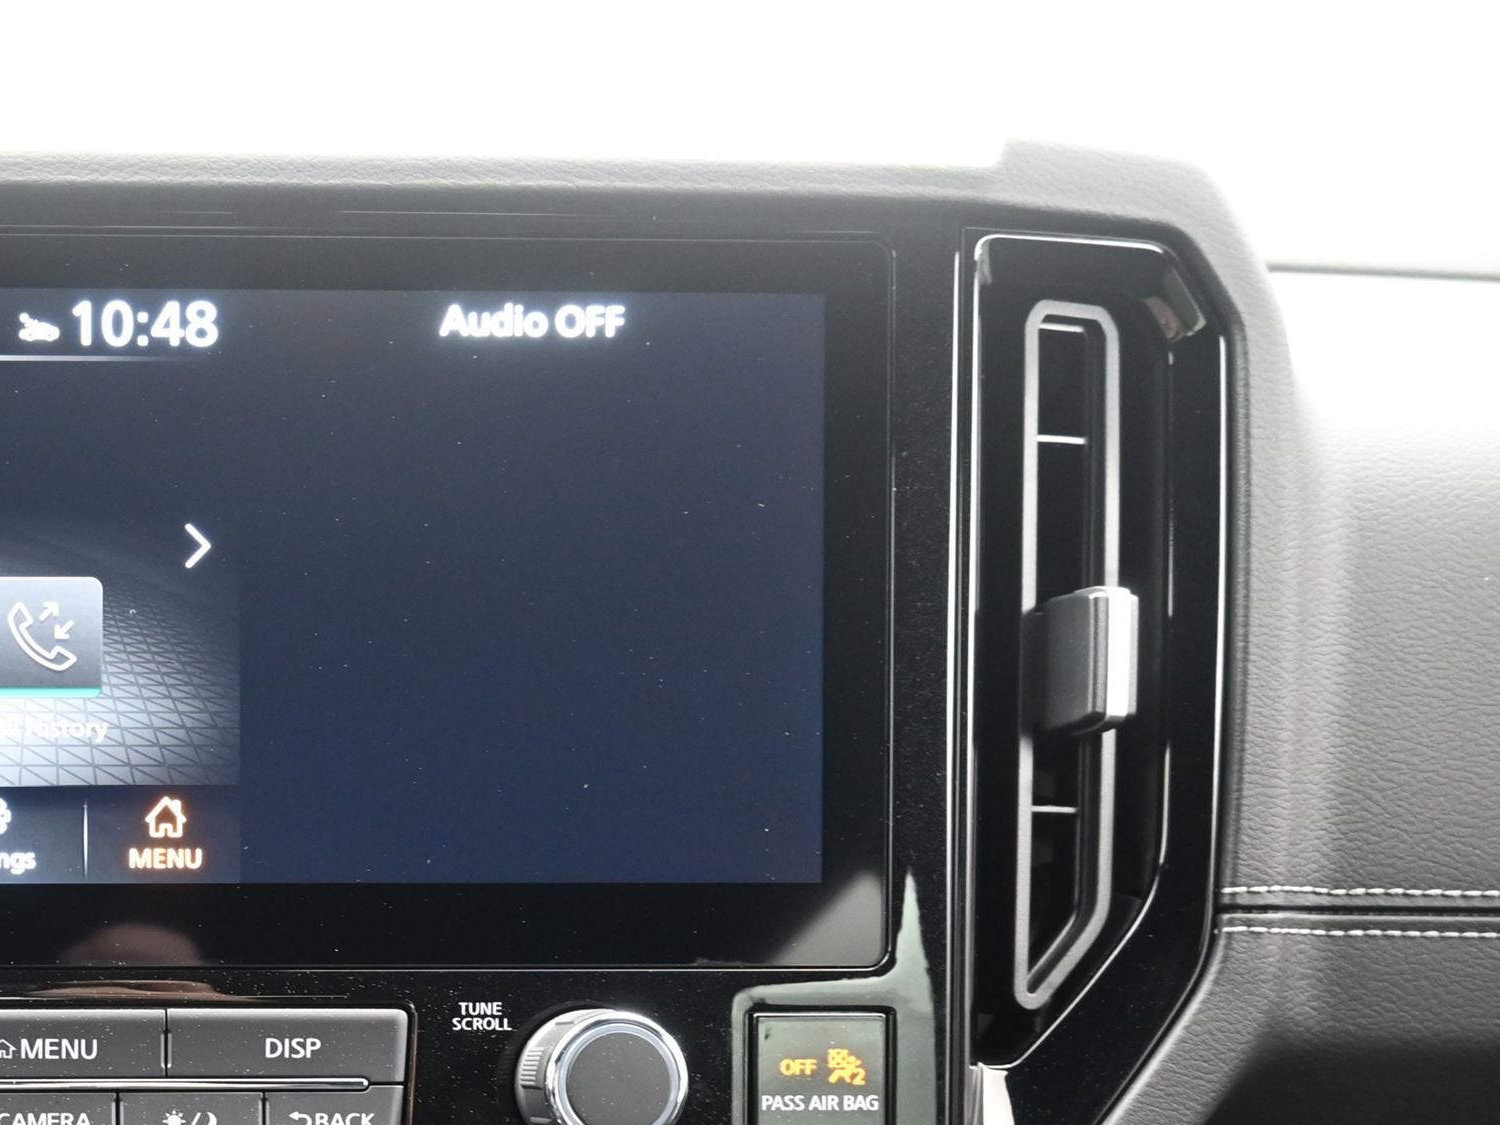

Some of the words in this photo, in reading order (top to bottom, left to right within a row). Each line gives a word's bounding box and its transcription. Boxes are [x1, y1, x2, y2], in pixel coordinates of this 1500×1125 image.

[71, 297, 221, 349] 10:48
[439, 304, 549, 338] Audio
[553, 304, 627, 338] OFF
[128, 847, 204, 871] MENU
[458, 1002, 503, 1016] TUNE
[451, 1016, 512, 1031] SCROLL
[20, 1038, 98, 1060] MENU
[265, 1037, 322, 1059] DISP
[780, 1058, 818, 1076] OFF
[761, 1094, 805, 1111] PASS
[808, 1094, 840, 1111] AIR
[843, 1094, 880, 1111] BAG
